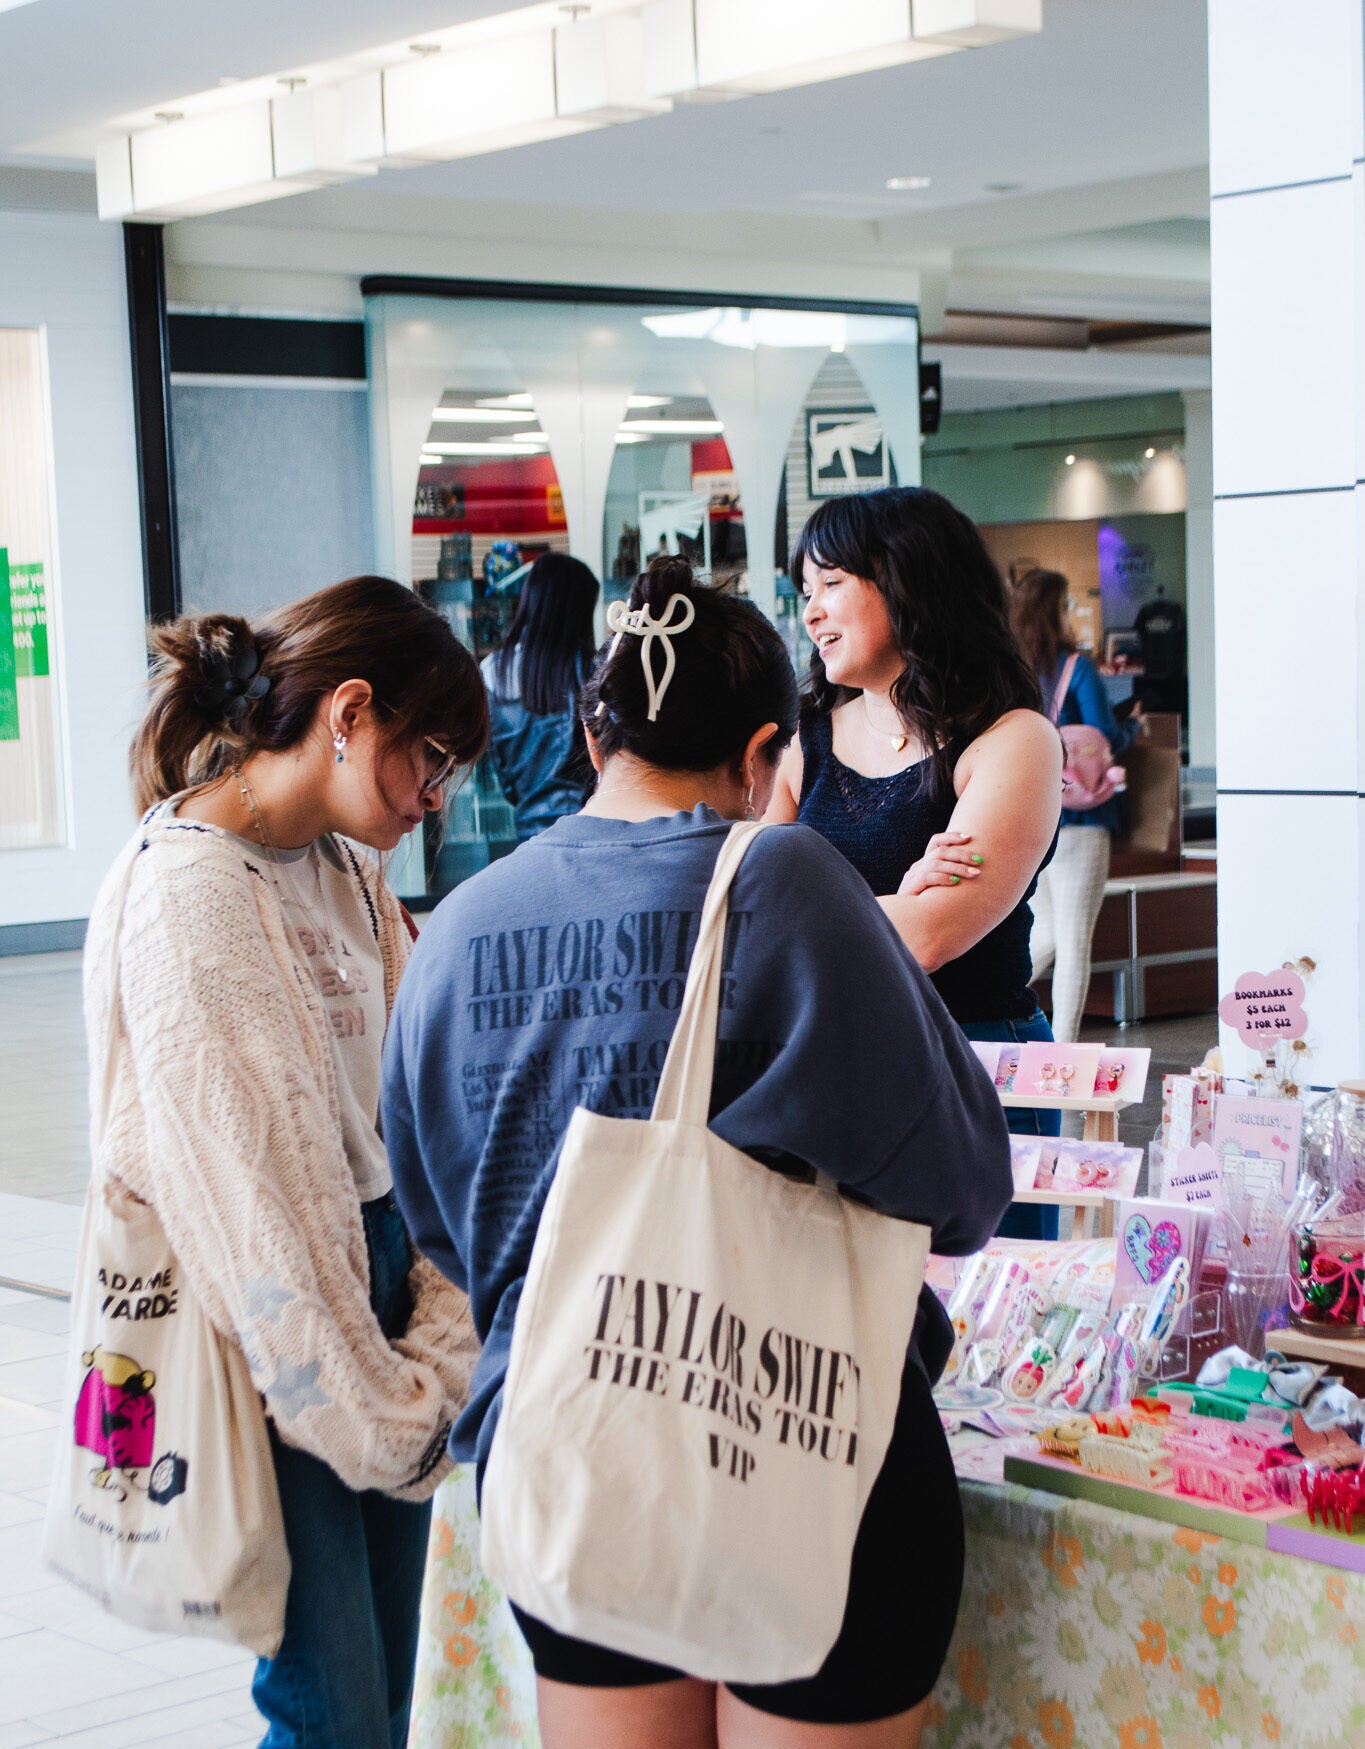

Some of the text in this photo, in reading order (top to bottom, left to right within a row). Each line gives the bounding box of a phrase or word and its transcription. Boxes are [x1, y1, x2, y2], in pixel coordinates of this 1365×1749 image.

[467, 910, 752, 998] TAYLOR SWIT
[468, 977, 736, 1033] THE ERAS TOR
[1235, 988, 1293, 1000] BOOKMARKS
[1246, 1003, 1286, 1015] $5 EACH
[1245, 1018, 1291, 1030] 3 FOR $12
[573, 1039, 671, 1078] TAYLO
[1235, 1112, 1281, 1127] PRICELIST
[98, 1268, 172, 1292] ADAME
[593, 1274, 746, 1389] TAYLOR
[584, 1347, 670, 1396] THE
[681, 1371, 762, 1435] ERAS
[708, 1433, 756, 1483] VIP
